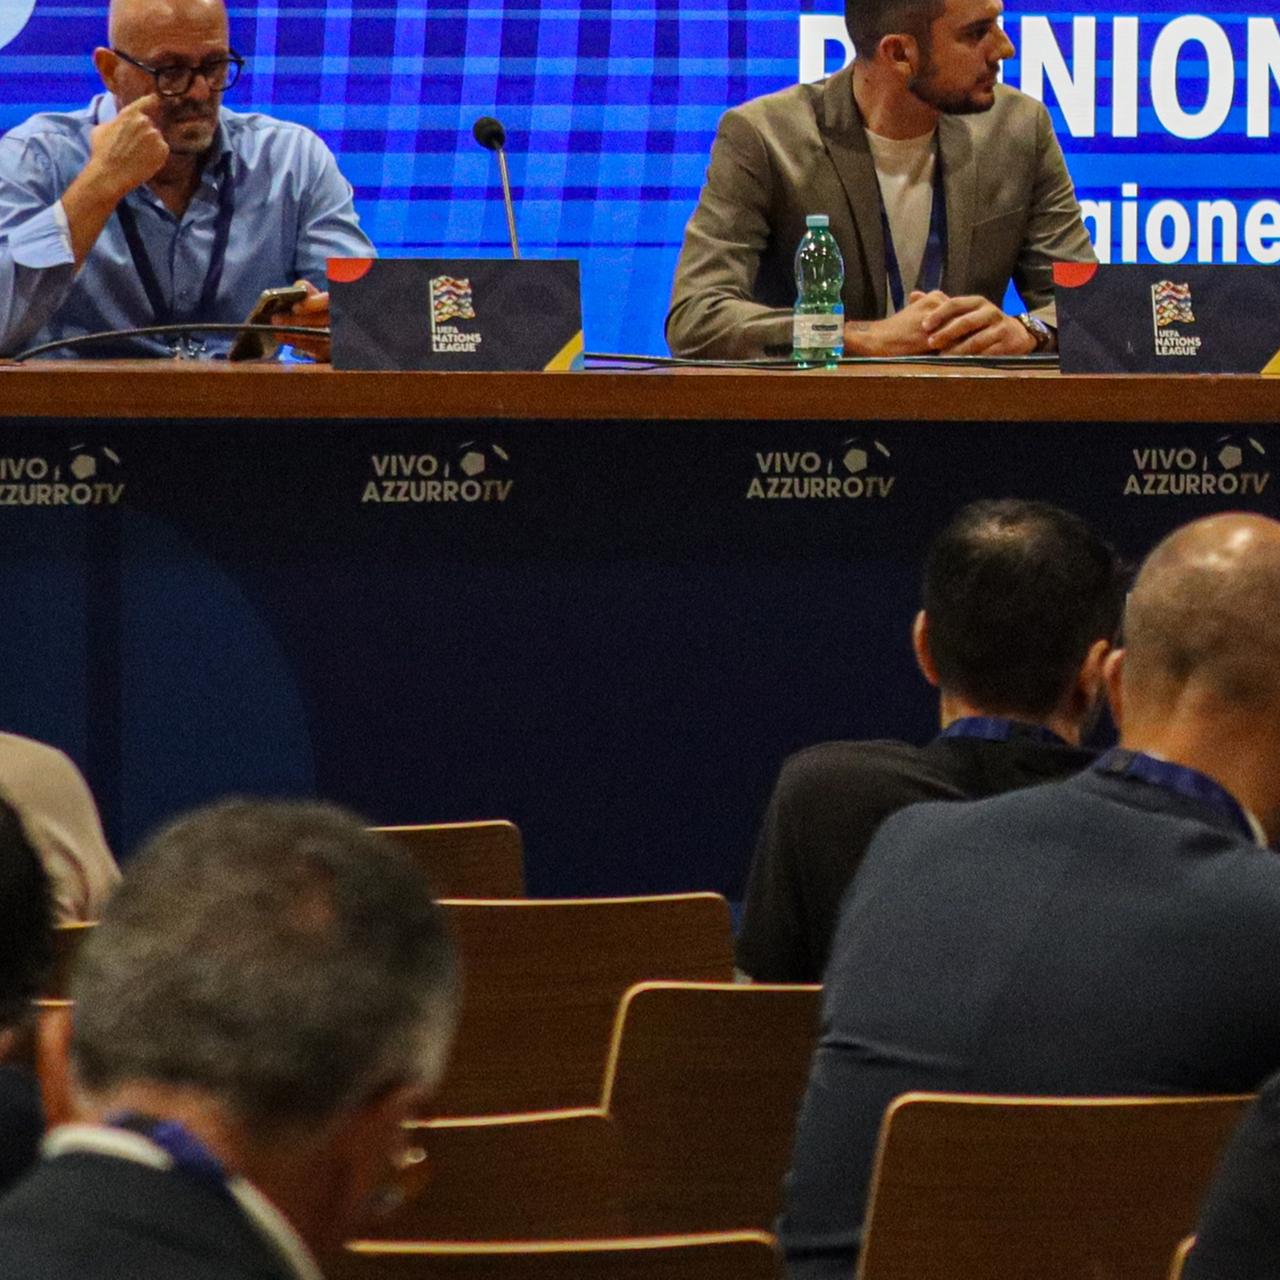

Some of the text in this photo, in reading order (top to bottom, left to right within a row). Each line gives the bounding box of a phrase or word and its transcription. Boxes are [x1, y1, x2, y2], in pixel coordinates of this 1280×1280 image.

[432, 333, 482, 343] NATIONS
[1155, 337, 1202, 347] NATIONS
[433, 343, 477, 353] LEAGUE
[1156, 347, 1198, 356] LEAGUE
[371, 454, 438, 477] VIVO
[756, 451, 822, 474] VIVO
[1132, 448, 1197, 470] VIVO
[0, 457, 48, 480] IVO
